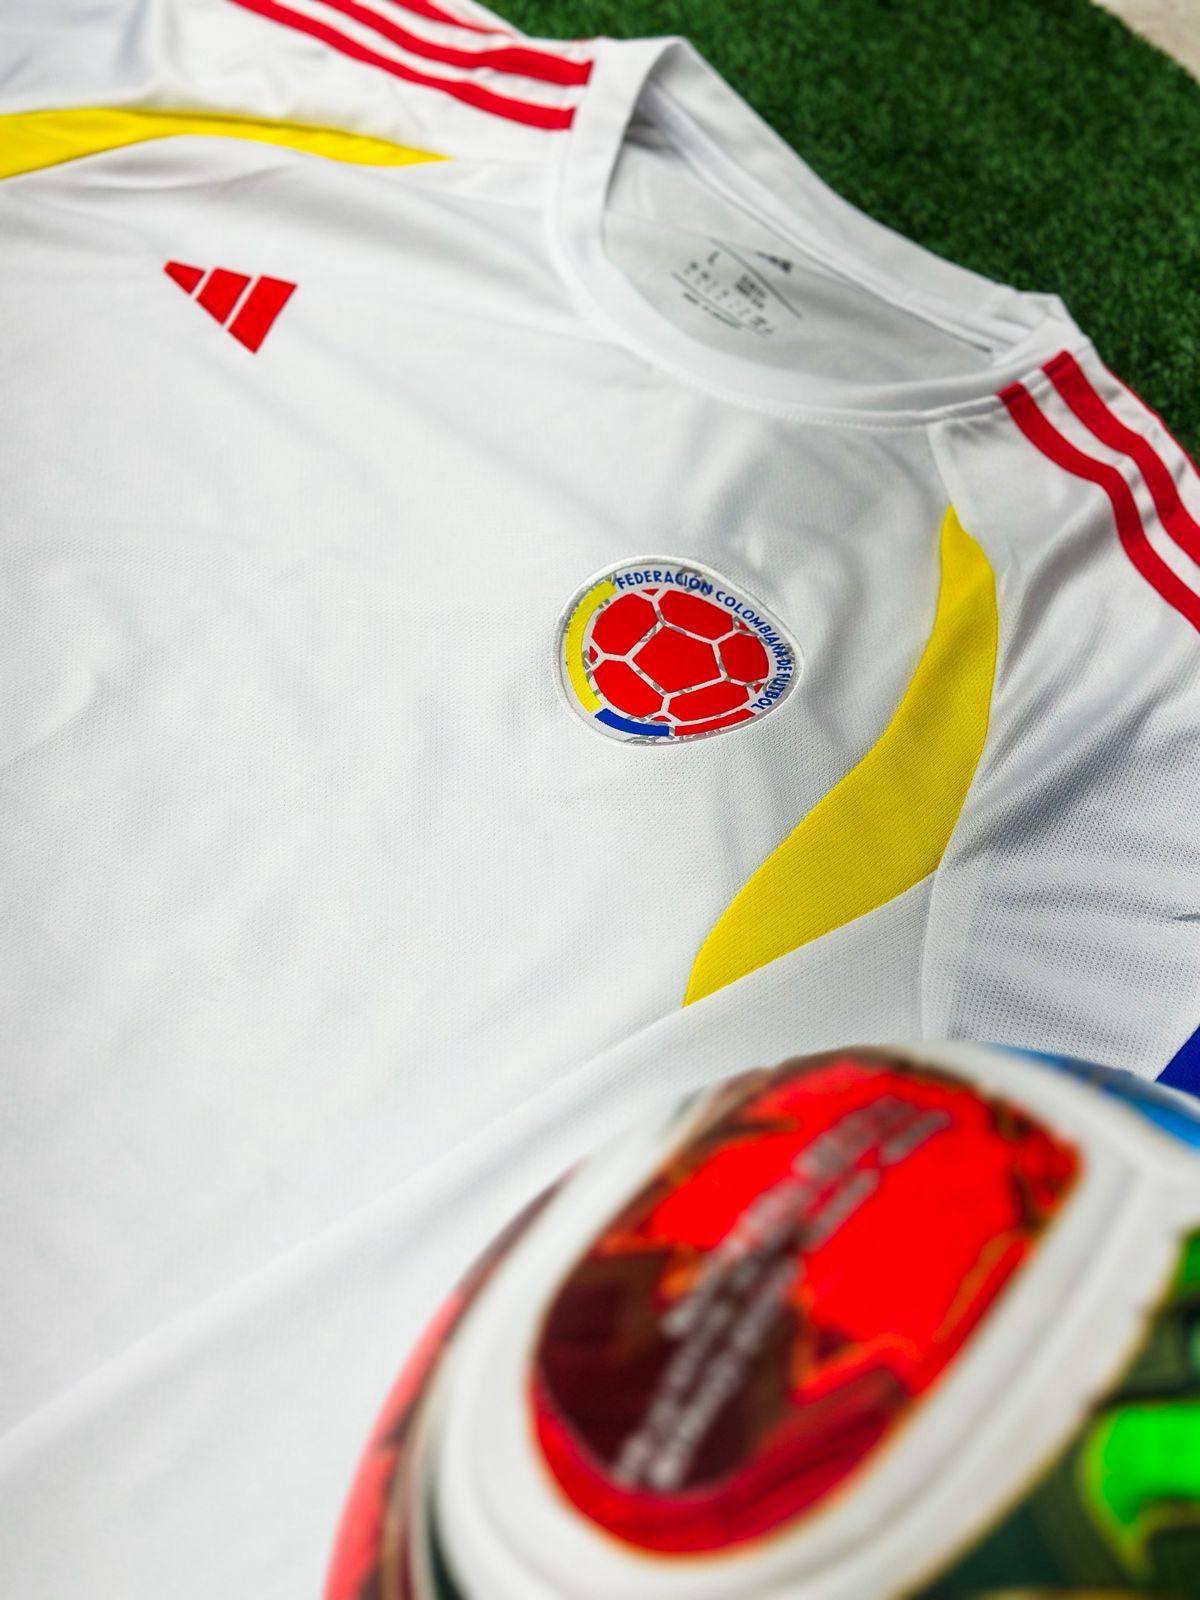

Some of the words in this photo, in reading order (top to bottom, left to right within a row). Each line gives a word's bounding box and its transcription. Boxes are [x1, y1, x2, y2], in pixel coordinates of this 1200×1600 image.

[716, 591, 789, 658] COLOMBIANA
[776, 658, 793, 671] DE
[750, 673, 791, 710] FUTBOL
